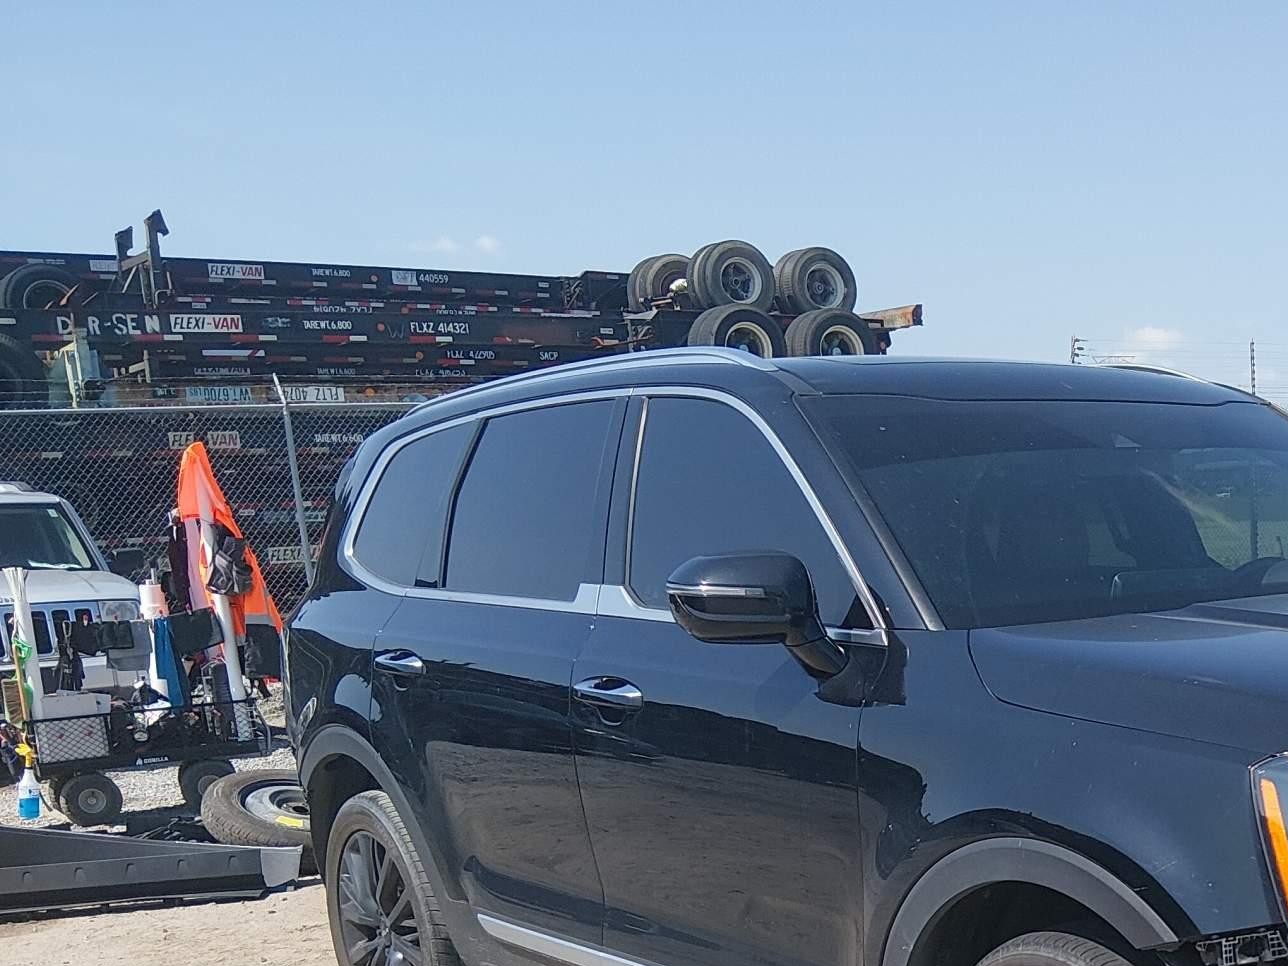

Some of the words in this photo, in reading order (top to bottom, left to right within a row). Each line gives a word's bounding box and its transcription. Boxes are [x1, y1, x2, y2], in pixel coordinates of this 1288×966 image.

[209, 264, 263, 277] FLEXI-VAN
[418, 274, 449, 284] 440559
[173, 316, 241, 331] FLEXI-VAN
[410, 322, 435, 333] FLXZ
[437, 322, 470, 334] 414321
[314, 387, 339, 401] FLTZ
